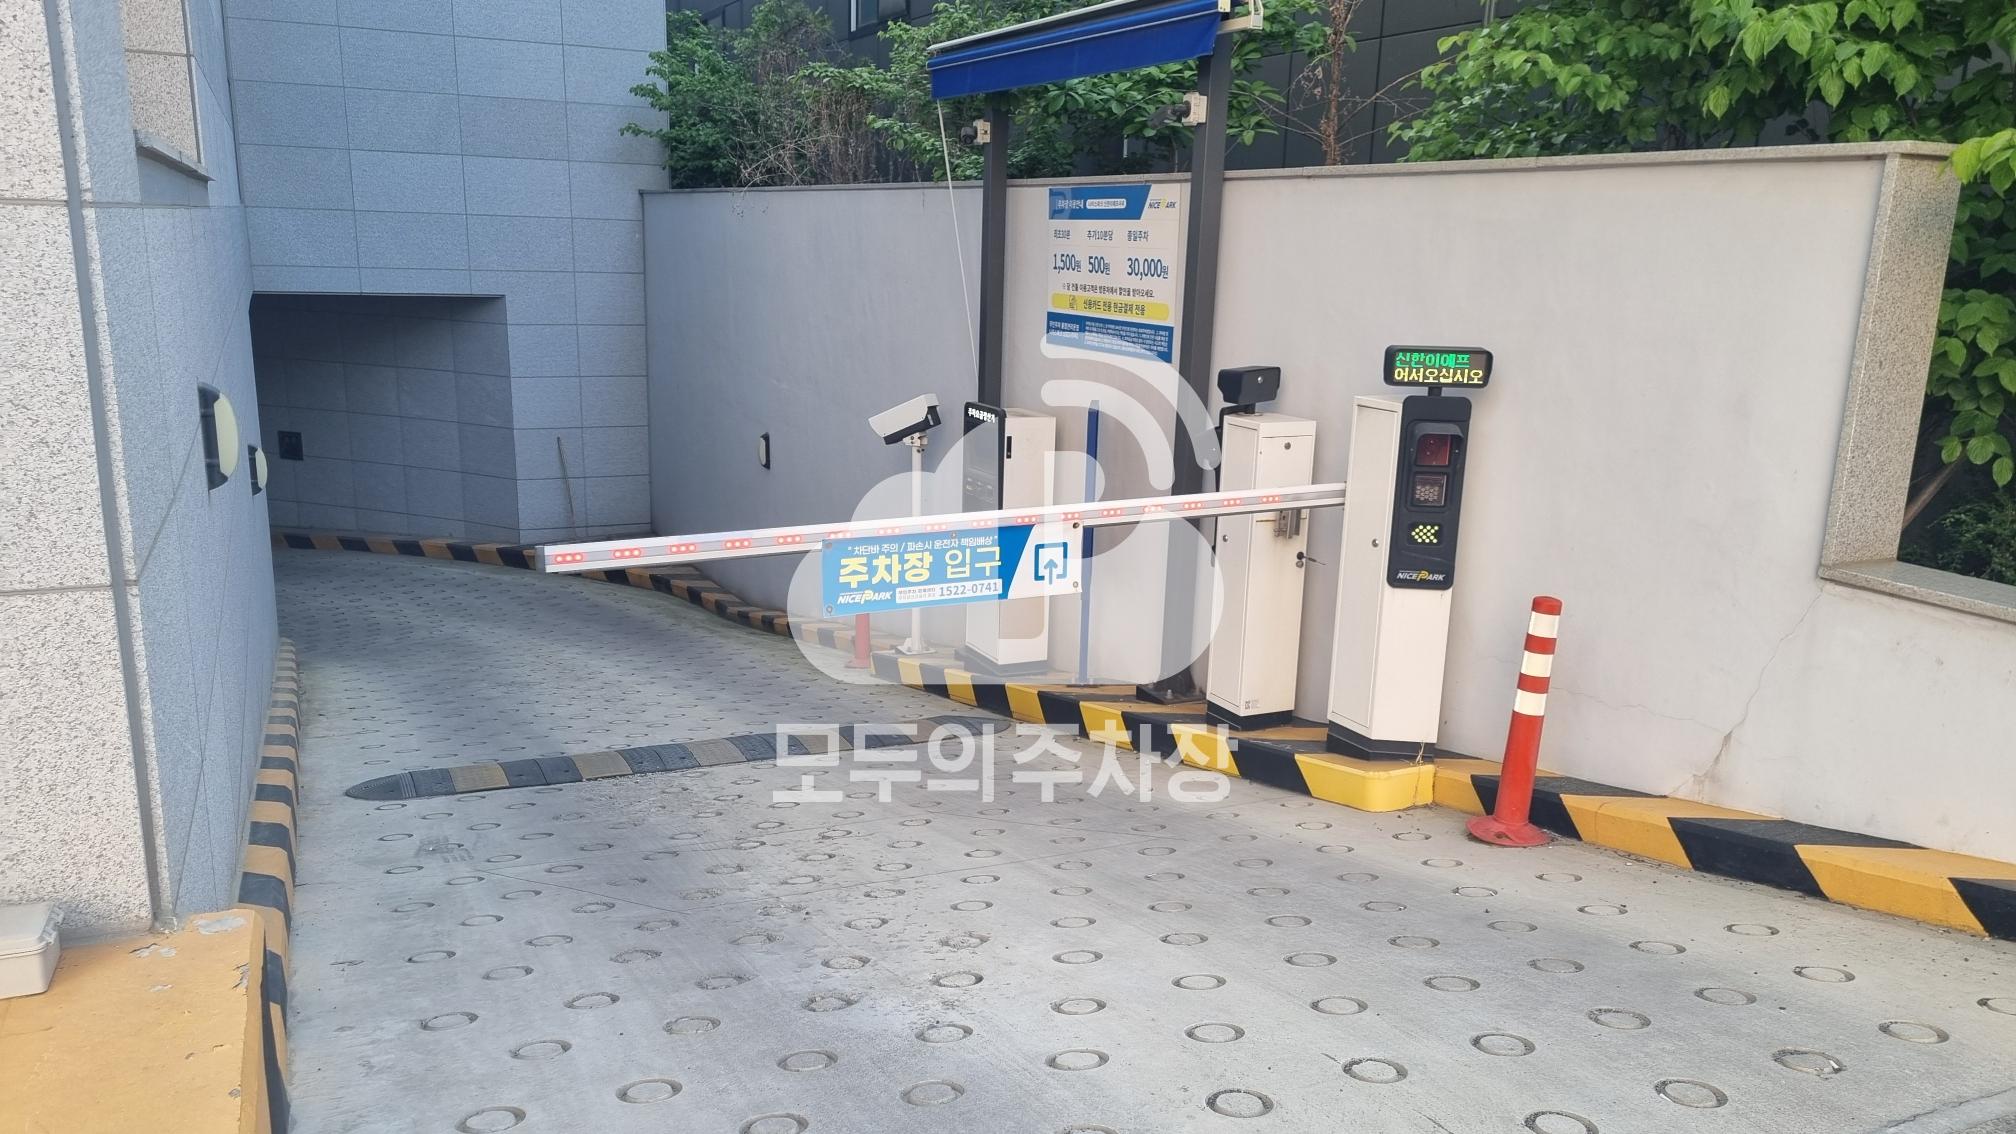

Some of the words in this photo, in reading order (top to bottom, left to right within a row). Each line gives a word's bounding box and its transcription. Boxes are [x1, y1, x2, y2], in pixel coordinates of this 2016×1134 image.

[1127, 230, 1149, 242] 종일주차
[1053, 253, 1081, 274] 1,500원
[1088, 256, 1111, 275] 500원
[1127, 257, 1168, 280] 30,000원
[1083, 299, 1101, 311] 신용카드
[1395, 352, 1471, 368] 신한이에프
[1394, 367, 1484, 384] 어서오십시오
[881, 543, 898, 554] 주의
[907, 540, 932, 552] 파손시
[934, 538, 959, 550] 운전자
[838, 550, 933, 589] 주차장
[944, 546, 1002, 579] 입구
[1396, 570, 1446, 581] NICEPARK
[837, 589, 892, 604] NICEPARK
[939, 581, 999, 598] 1522-0741
